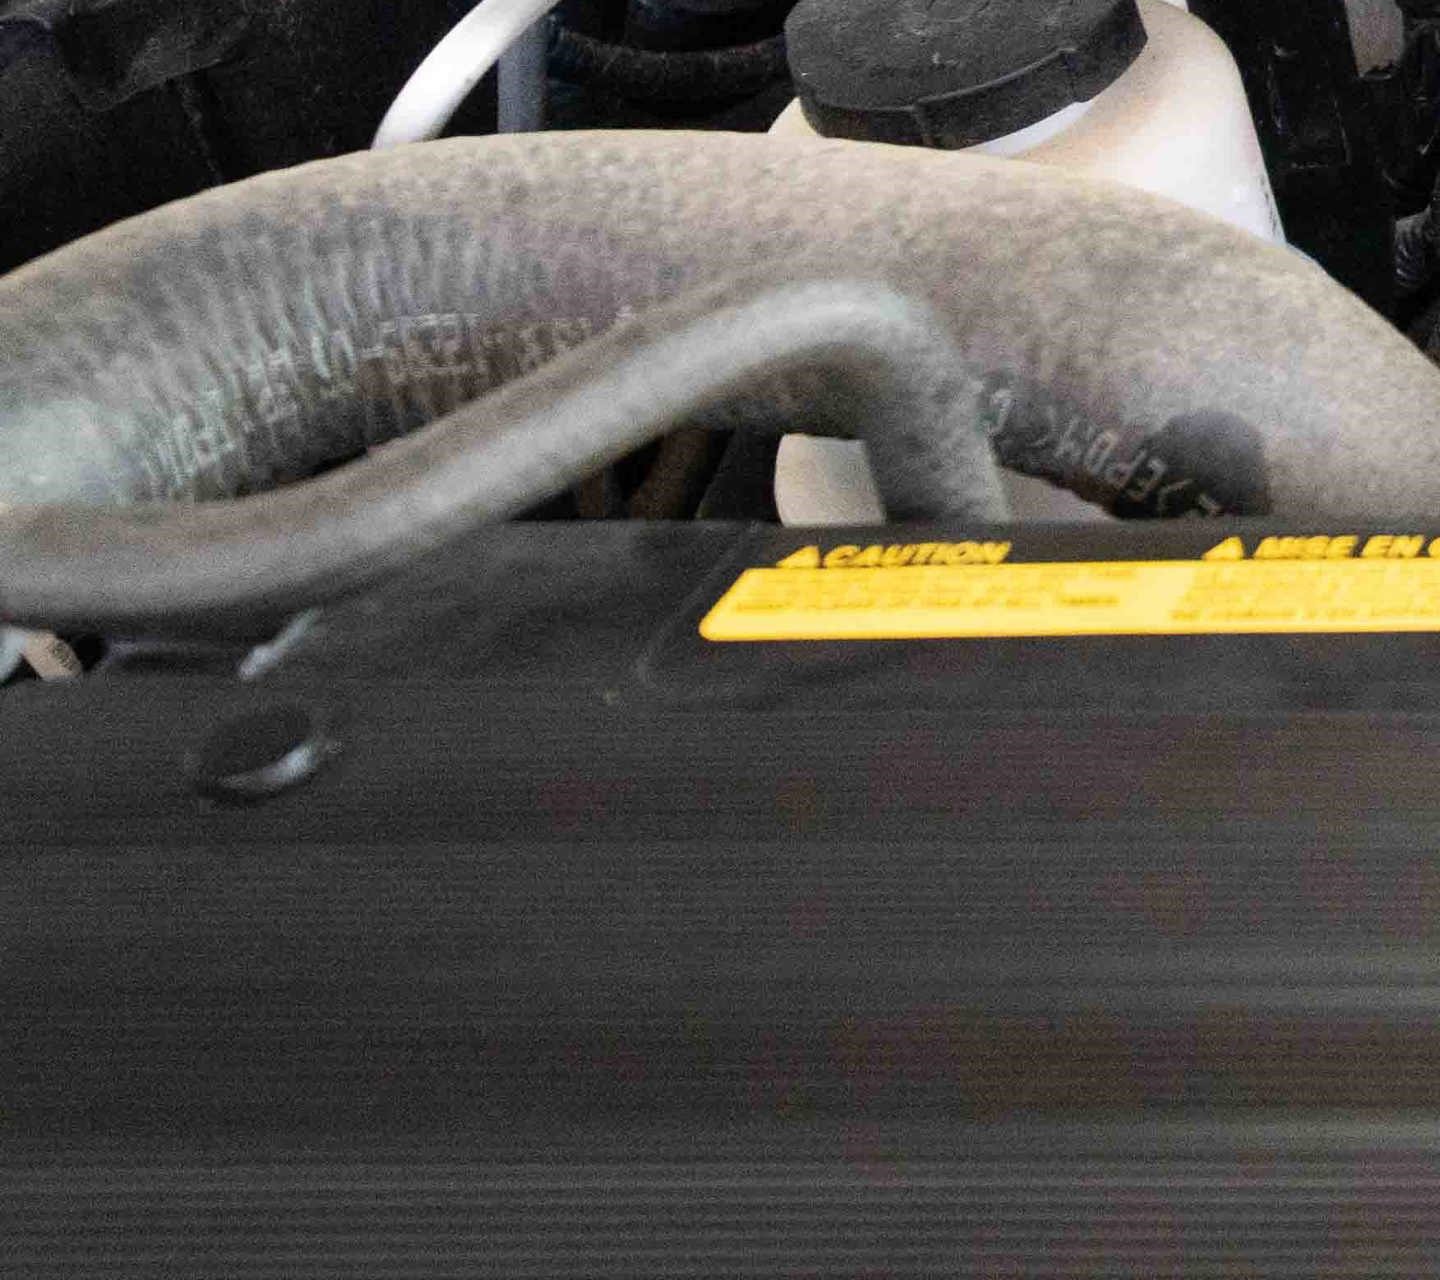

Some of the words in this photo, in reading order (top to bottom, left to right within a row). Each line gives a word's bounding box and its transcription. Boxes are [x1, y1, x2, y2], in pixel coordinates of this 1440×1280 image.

[823, 539, 1013, 568] CAUTION
[1252, 535, 1360, 560] MISE
[1360, 534, 1426, 559] EN
